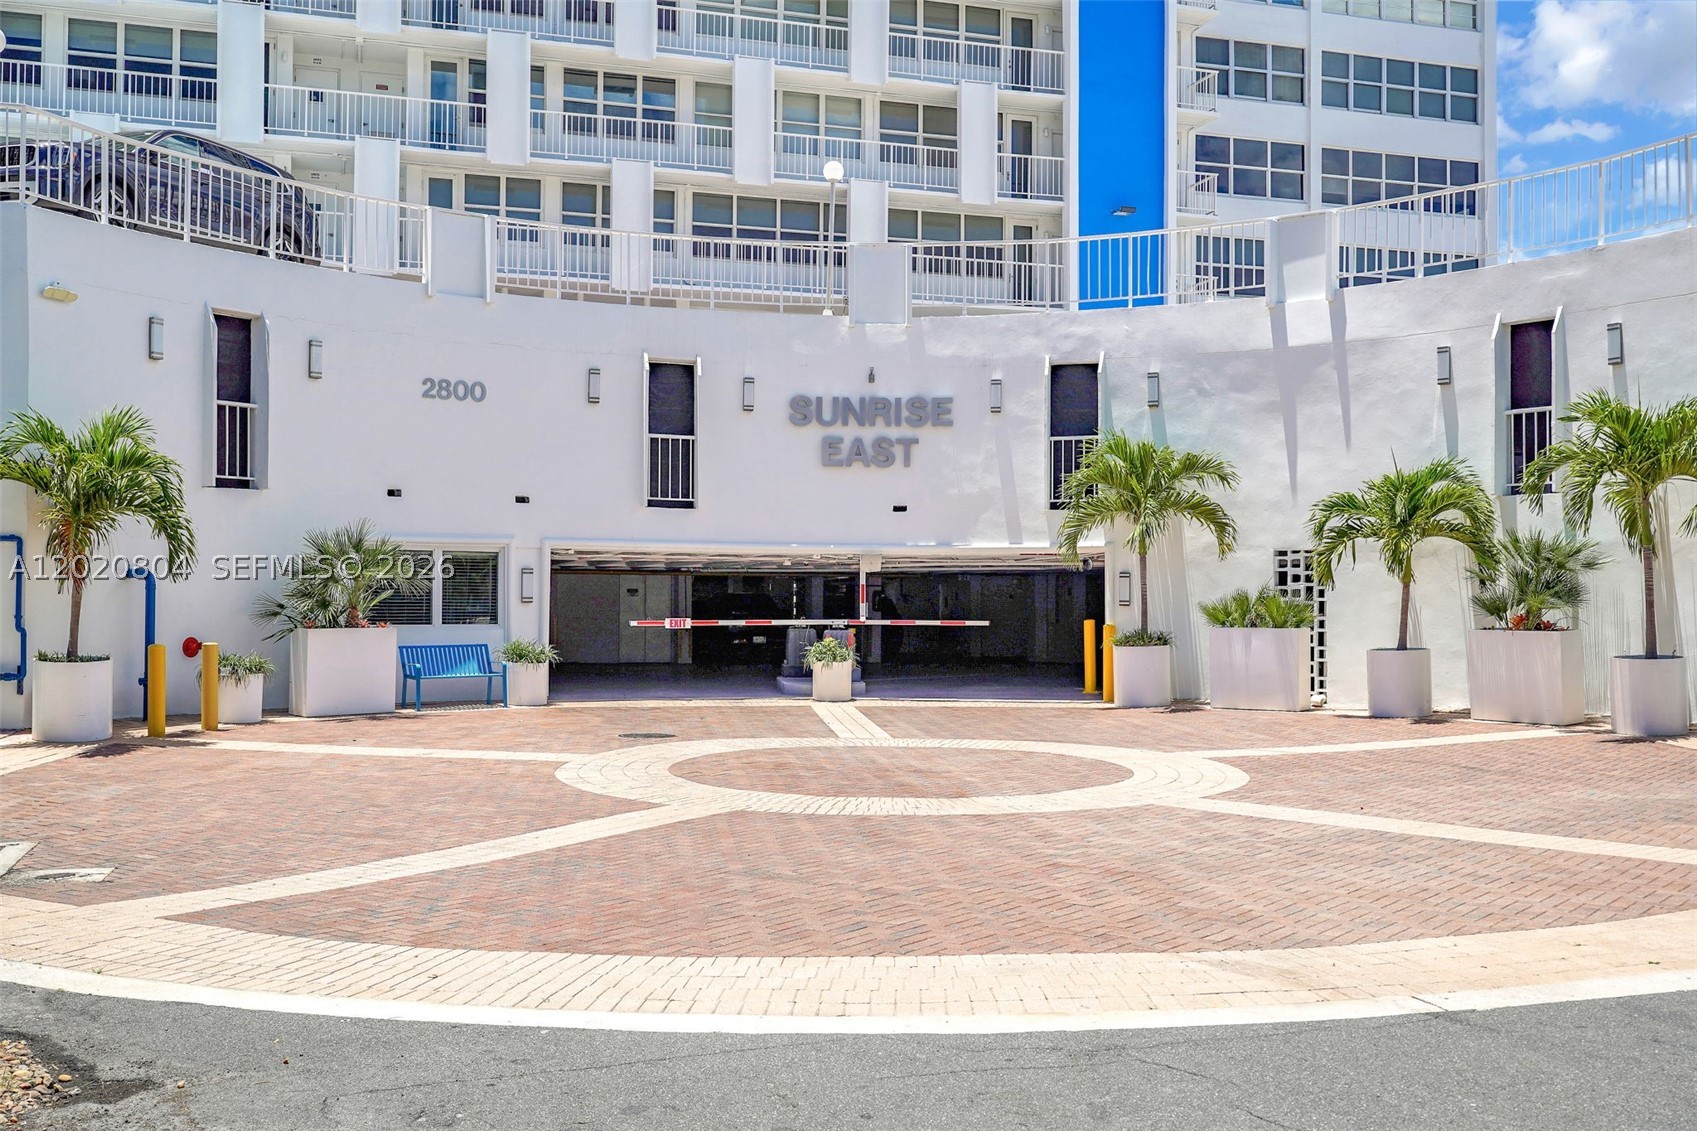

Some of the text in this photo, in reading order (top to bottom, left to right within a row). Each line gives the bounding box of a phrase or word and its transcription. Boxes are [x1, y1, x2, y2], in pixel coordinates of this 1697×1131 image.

[421, 378, 487, 403] 2800
[788, 394, 954, 428] SUNRISE
[821, 436, 920, 468] EAST
[669, 618, 687, 628] EXIT
